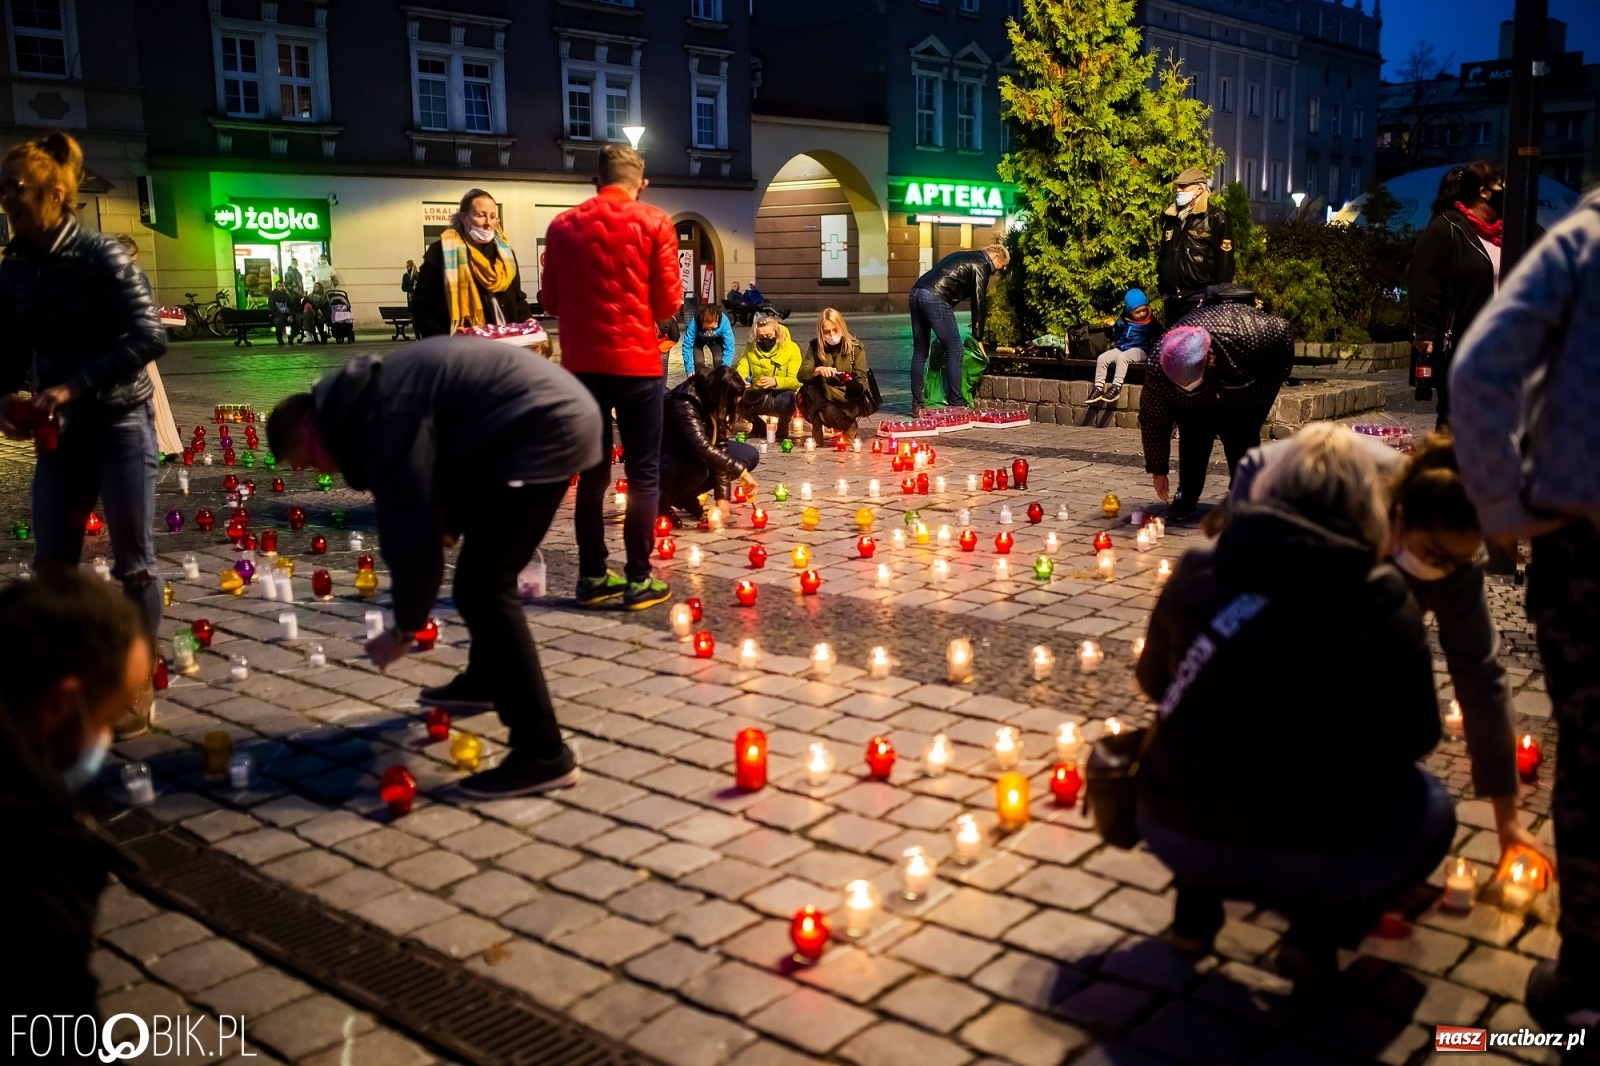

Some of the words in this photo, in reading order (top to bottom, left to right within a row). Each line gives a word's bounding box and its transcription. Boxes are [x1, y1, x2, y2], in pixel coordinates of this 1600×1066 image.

[904, 183, 1003, 208] APTEKA
[245, 206, 318, 229] żabka
[684, 252, 692, 267] 432
